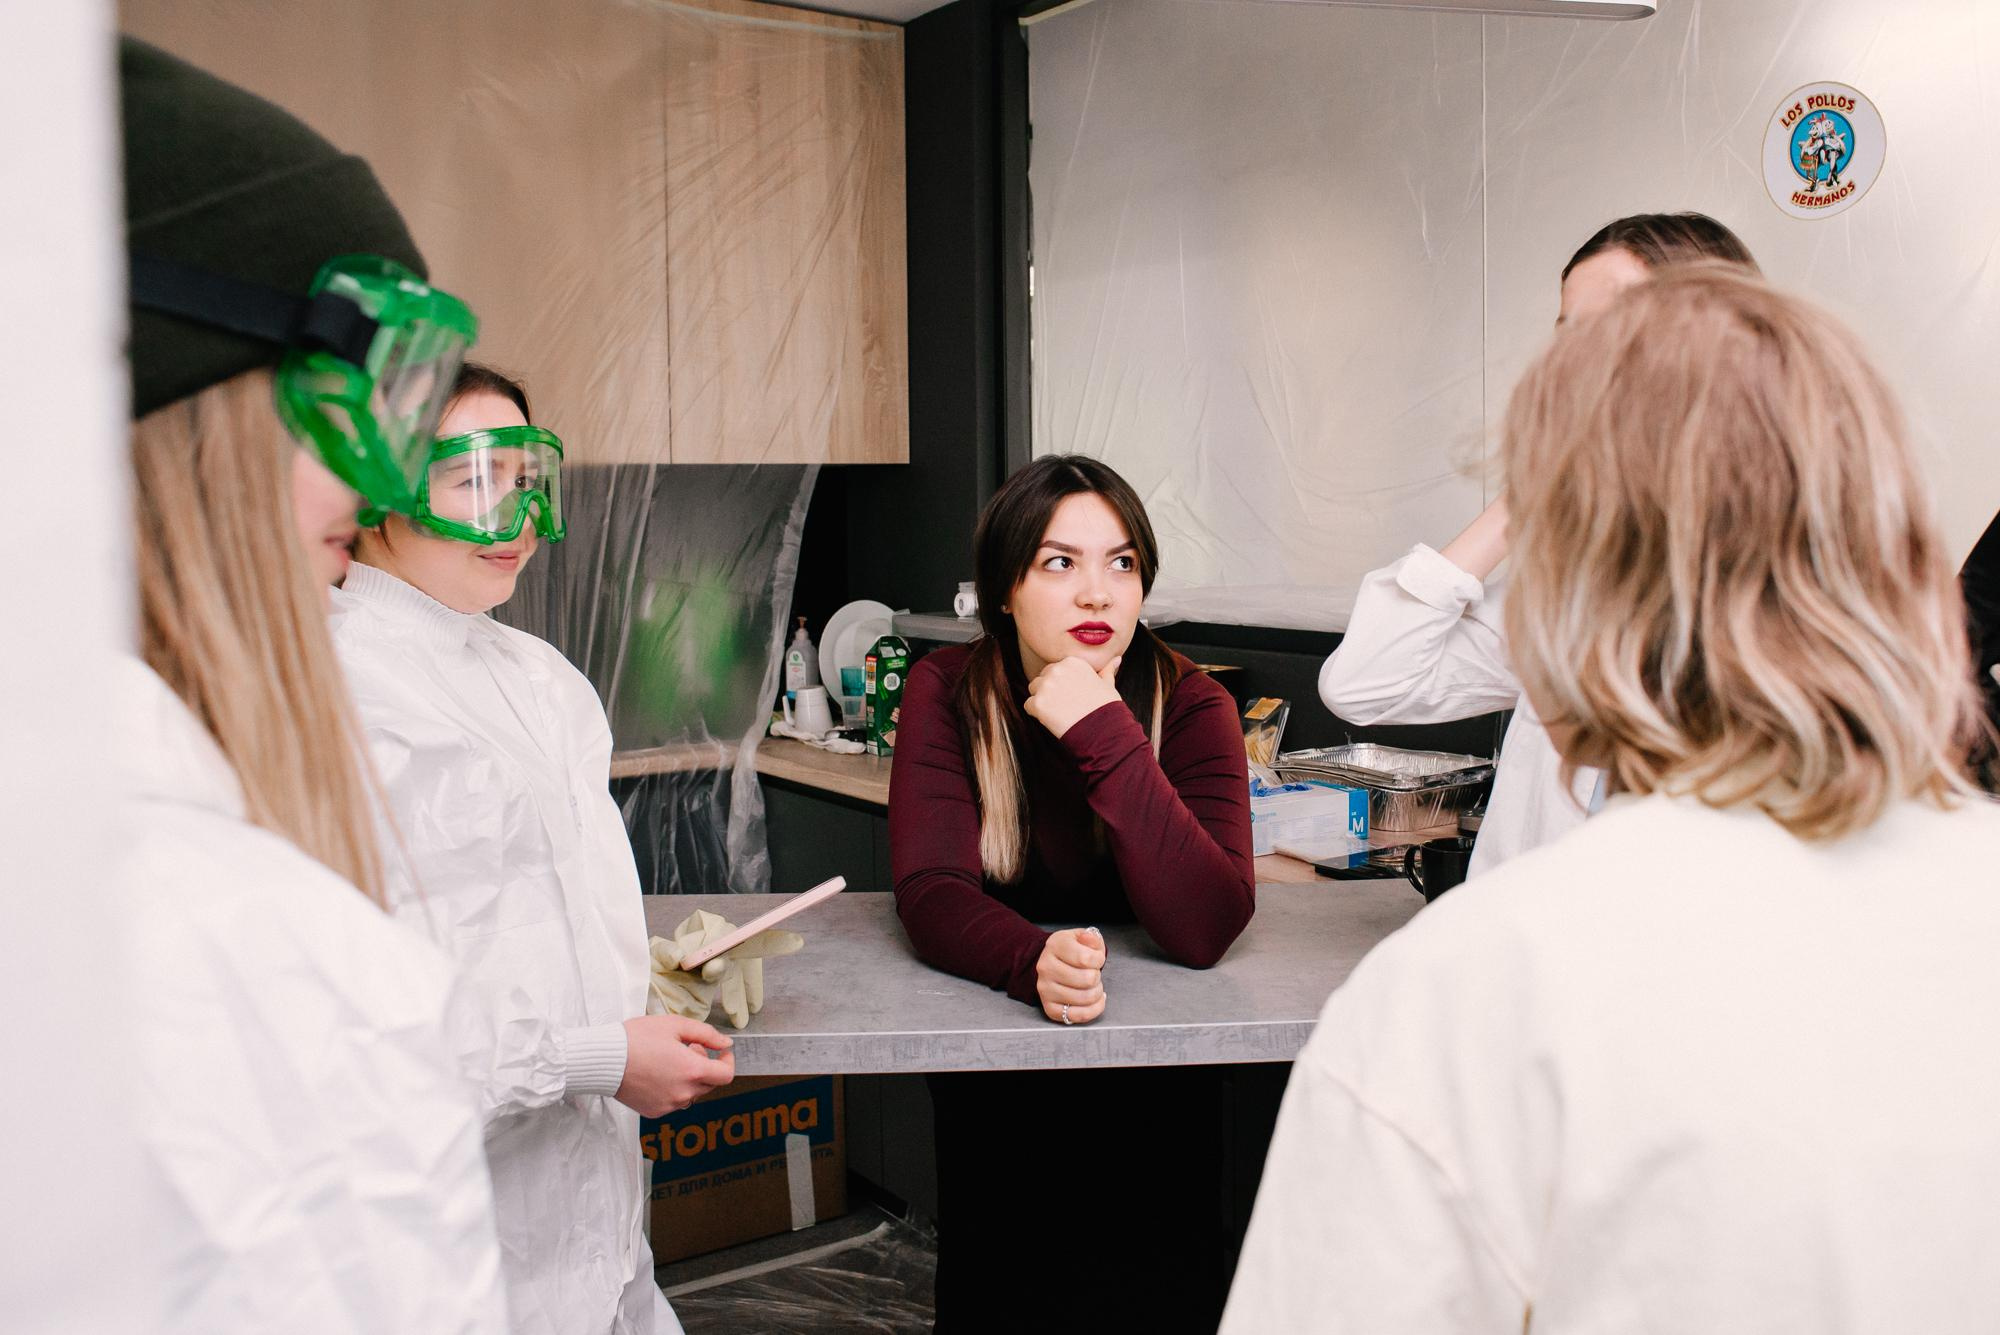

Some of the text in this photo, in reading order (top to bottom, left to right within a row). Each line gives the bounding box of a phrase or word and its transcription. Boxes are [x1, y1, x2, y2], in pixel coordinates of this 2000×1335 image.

[1780, 94, 1855, 129] LOS POLLOS
[1792, 181, 1855, 206] HERMANOS
[1352, 816, 1364, 833] M
[678, 1178, 708, 1196] ДЛЯ
[711, 1166, 752, 1187] ДОМА
